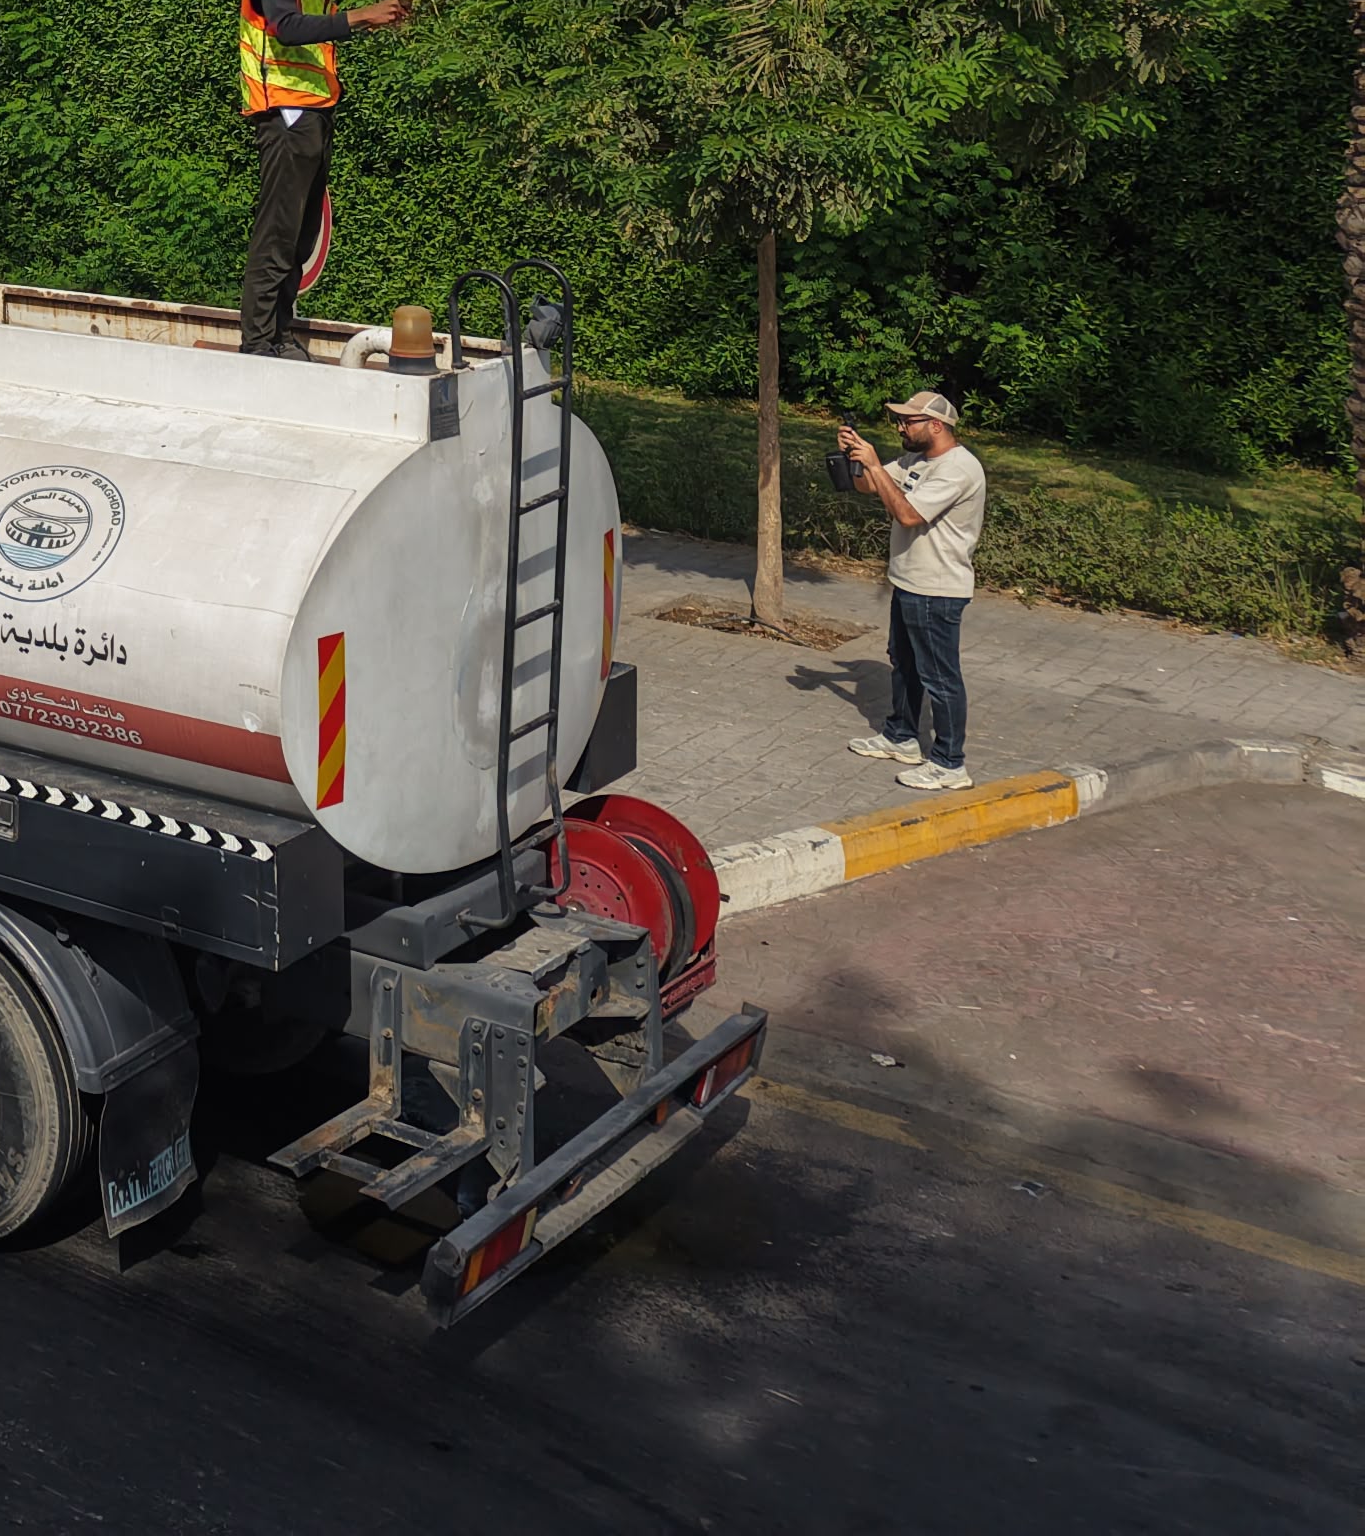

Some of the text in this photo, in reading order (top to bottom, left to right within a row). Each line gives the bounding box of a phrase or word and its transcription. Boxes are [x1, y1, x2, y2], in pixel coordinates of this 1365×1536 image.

[22, 491, 84, 514] مدينة السلام
[70, 469, 93, 482] OF
[91, 477, 122, 527] BAGHDAD
[27, 571, 65, 592] أمانة
[0, 611, 69, 662] بلدية
[73, 627, 128, 666] دائرة
[6, 686, 126, 723] هاتف الشكاوي
